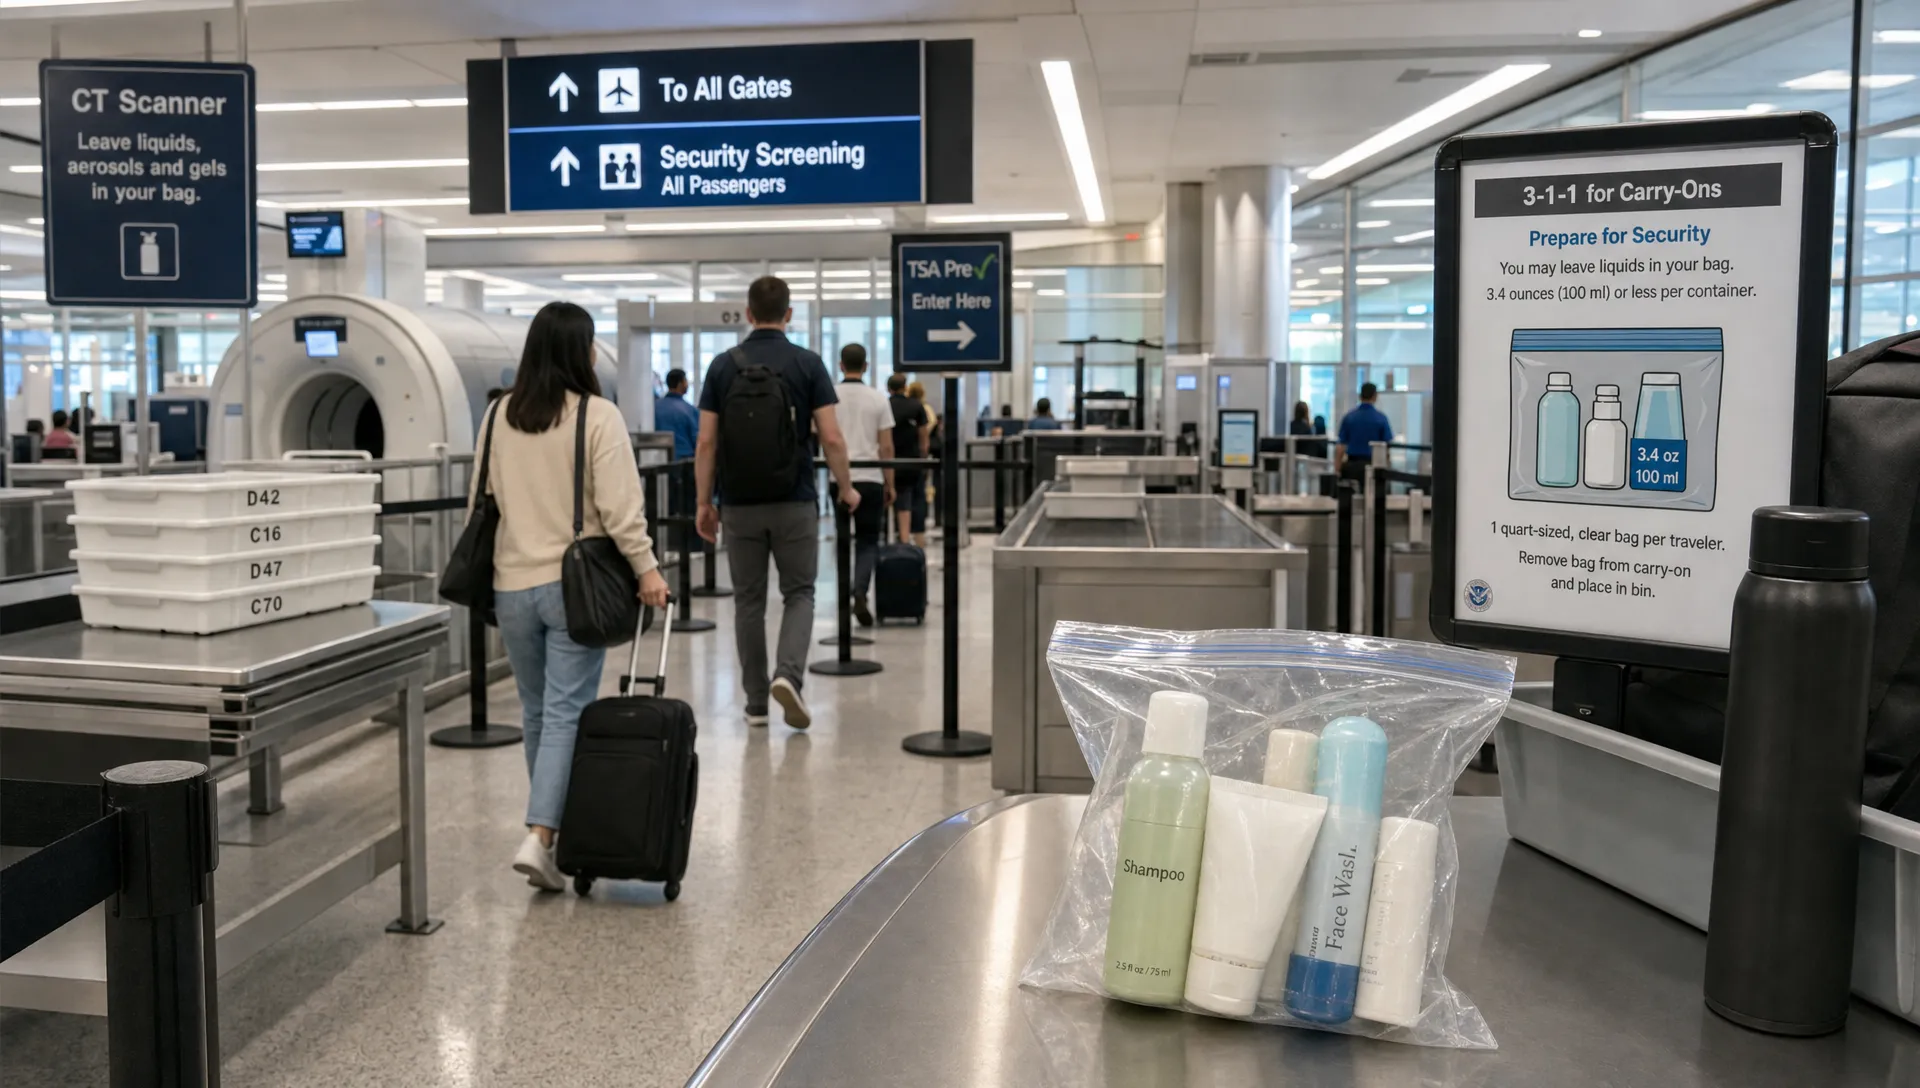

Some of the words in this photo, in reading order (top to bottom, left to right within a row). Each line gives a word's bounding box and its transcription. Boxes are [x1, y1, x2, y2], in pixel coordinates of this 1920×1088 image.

[658, 77, 688, 102] To
[693, 76, 722, 101] All
[728, 75, 792, 100] Gates
[72, 88, 108, 113] CT
[119, 88, 227, 115] Scanner
[78, 132, 131, 150] Leave
[137, 133, 201, 154] liquids,
[660, 143, 750, 172] Security
[756, 140, 865, 170] Screening
[68, 158, 144, 176] aerosols
[150, 159, 183, 176] and
[189, 159, 227, 180] gels
[92, 182, 108, 199] in
[115, 185, 156, 205] your
[162, 183, 201, 205] bag.
[661, 175, 684, 195] All
[690, 175, 786, 198] Passengers
[1523, 184, 1576, 206] 3-1-1
[1586, 183, 1614, 203] for
[1619, 179, 1722, 204] Carry-Ons
[1530, 230, 1597, 249] Prepare
[1602, 227, 1627, 244] for
[1632, 224, 1711, 246] Security
[907, 260, 941, 278] TSA
[944, 260, 973, 278] Pre
[1500, 262, 1524, 275] You
[1528, 263, 1556, 277] may
[1560, 260, 1595, 274] leave
[1600, 258, 1644, 273] liquids
[1649, 257, 1661, 272] in
[1666, 258, 1698, 273] your
[1703, 257, 1734, 274] bag.
[912, 292, 952, 310] Enter
[955, 292, 991, 309] Here
[1487, 288, 1505, 301] 3.4
[1510, 289, 1554, 300] ounces
[1558, 286, 1586, 301] (100
[1590, 285, 1610, 301] ml)
[1615, 287, 1628, 299] or
[1632, 285, 1657, 298] less
[1661, 286, 1683, 301] per
[1687, 283, 1756, 298] container.
[1637, 447, 1659, 462] 3.4
[1663, 451, 1679, 462] oz
[1635, 470, 1659, 483] 100
[1663, 472, 1678, 484] ml
[247, 489, 280, 506] D42
[250, 526, 281, 543] C16
[1491, 522, 1497, 533] 1
[1501, 523, 1574, 541] quart-sized,
[1579, 527, 1611, 542] clear
[1614, 529, 1639, 547] bag
[1643, 534, 1666, 548] per
[1670, 534, 1725, 551] traveler.
[251, 561, 282, 579] D47
[1519, 551, 1567, 567] Remove
[1571, 554, 1595, 572] bag
[1599, 557, 1630, 572] from
[1633, 561, 1691, 578] carry-on
[1551, 577, 1574, 591] and
[1578, 579, 1612, 595] place
[1616, 583, 1627, 595] in
[1631, 583, 1655, 598] bin.
[251, 596, 282, 615] C70
[1123, 859, 1185, 882] Shampoo
[1325, 905, 1348, 951] Face
[1128, 963, 1133, 971] fl
[1145, 966, 1150, 975] /
[1150, 967, 1160, 976] 75
[1162, 968, 1171, 976] ml
